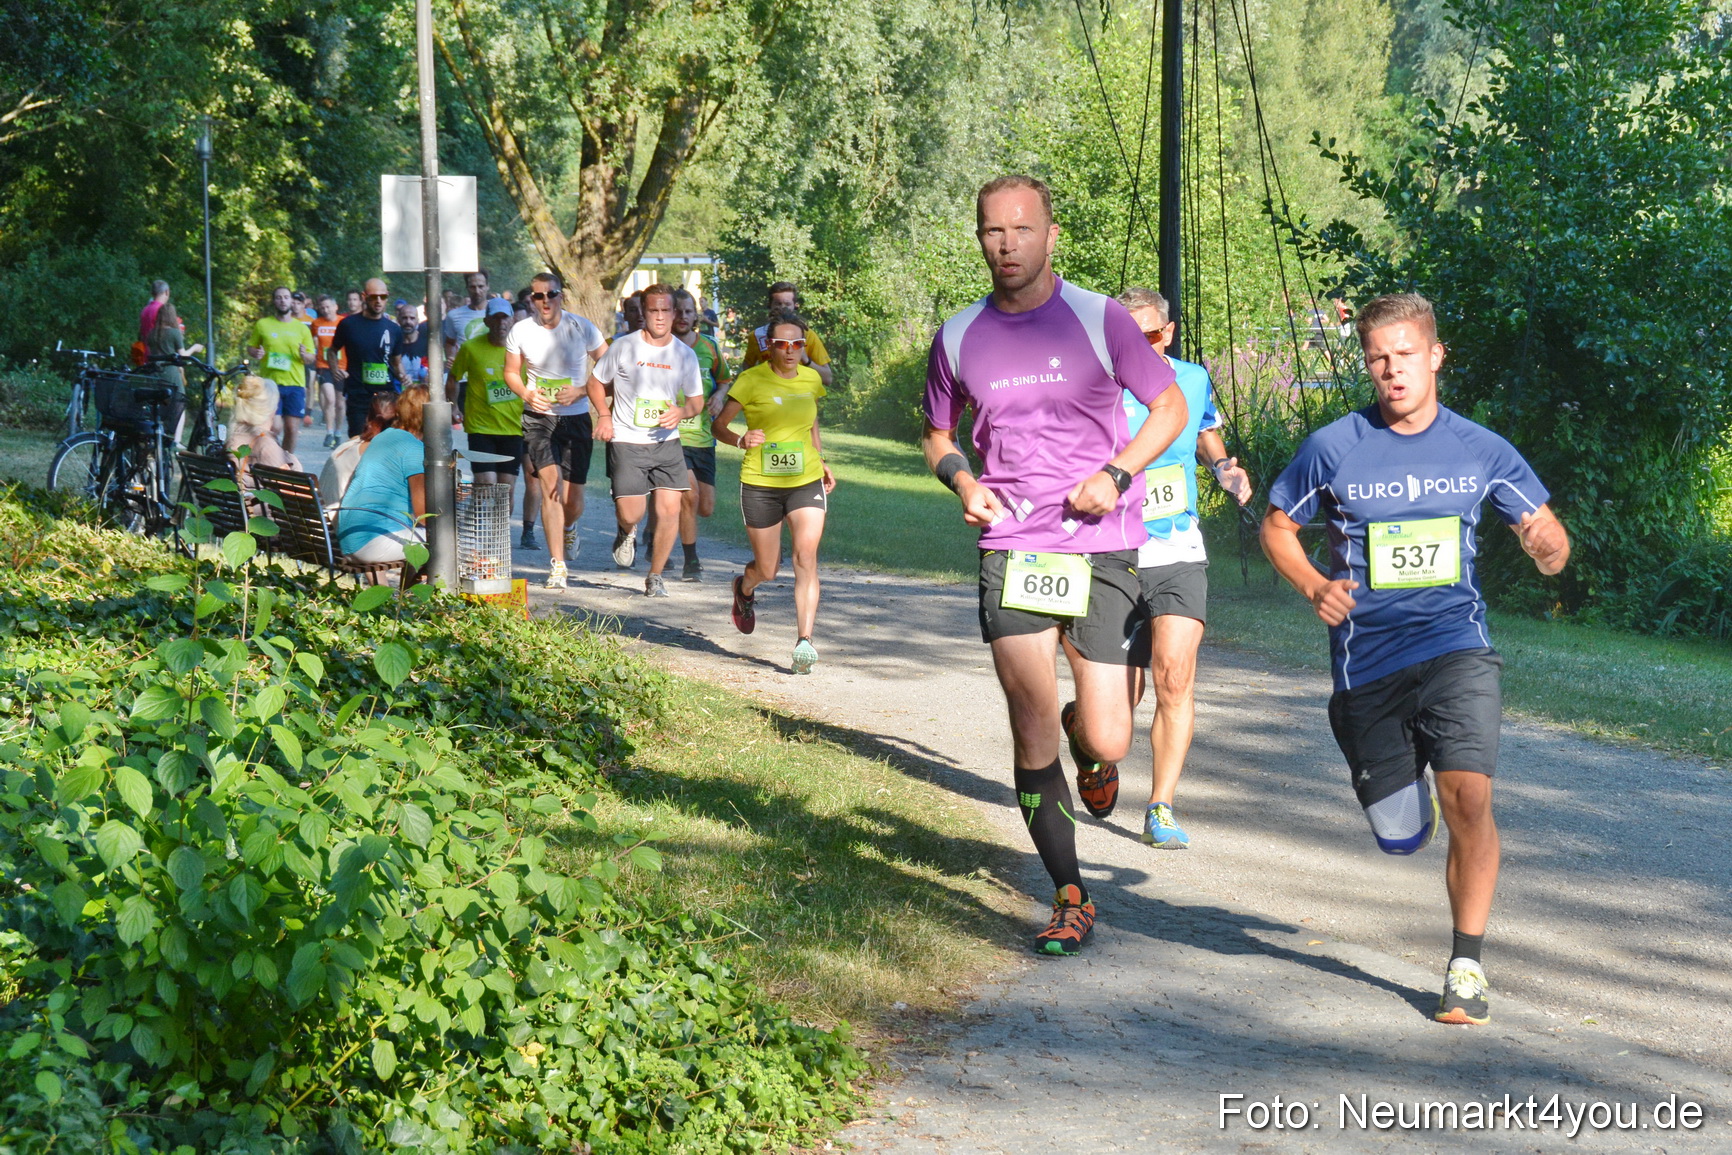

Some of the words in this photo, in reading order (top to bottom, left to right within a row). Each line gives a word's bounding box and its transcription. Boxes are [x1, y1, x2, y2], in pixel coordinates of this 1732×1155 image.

[365, 370, 386, 378] 1603
[989, 378, 1010, 391] WIR
[1012, 374, 1037, 386] SIND
[1040, 372, 1067, 383] LILA.
[493, 387, 512, 398] 906
[771, 453, 797, 467] 943
[1347, 481, 1404, 501] EURO
[1423, 476, 1478, 495] POLES
[1391, 543, 1441, 569] 537
[1422, 568, 1436, 576] Max
[1023, 574, 1070, 598] 680
